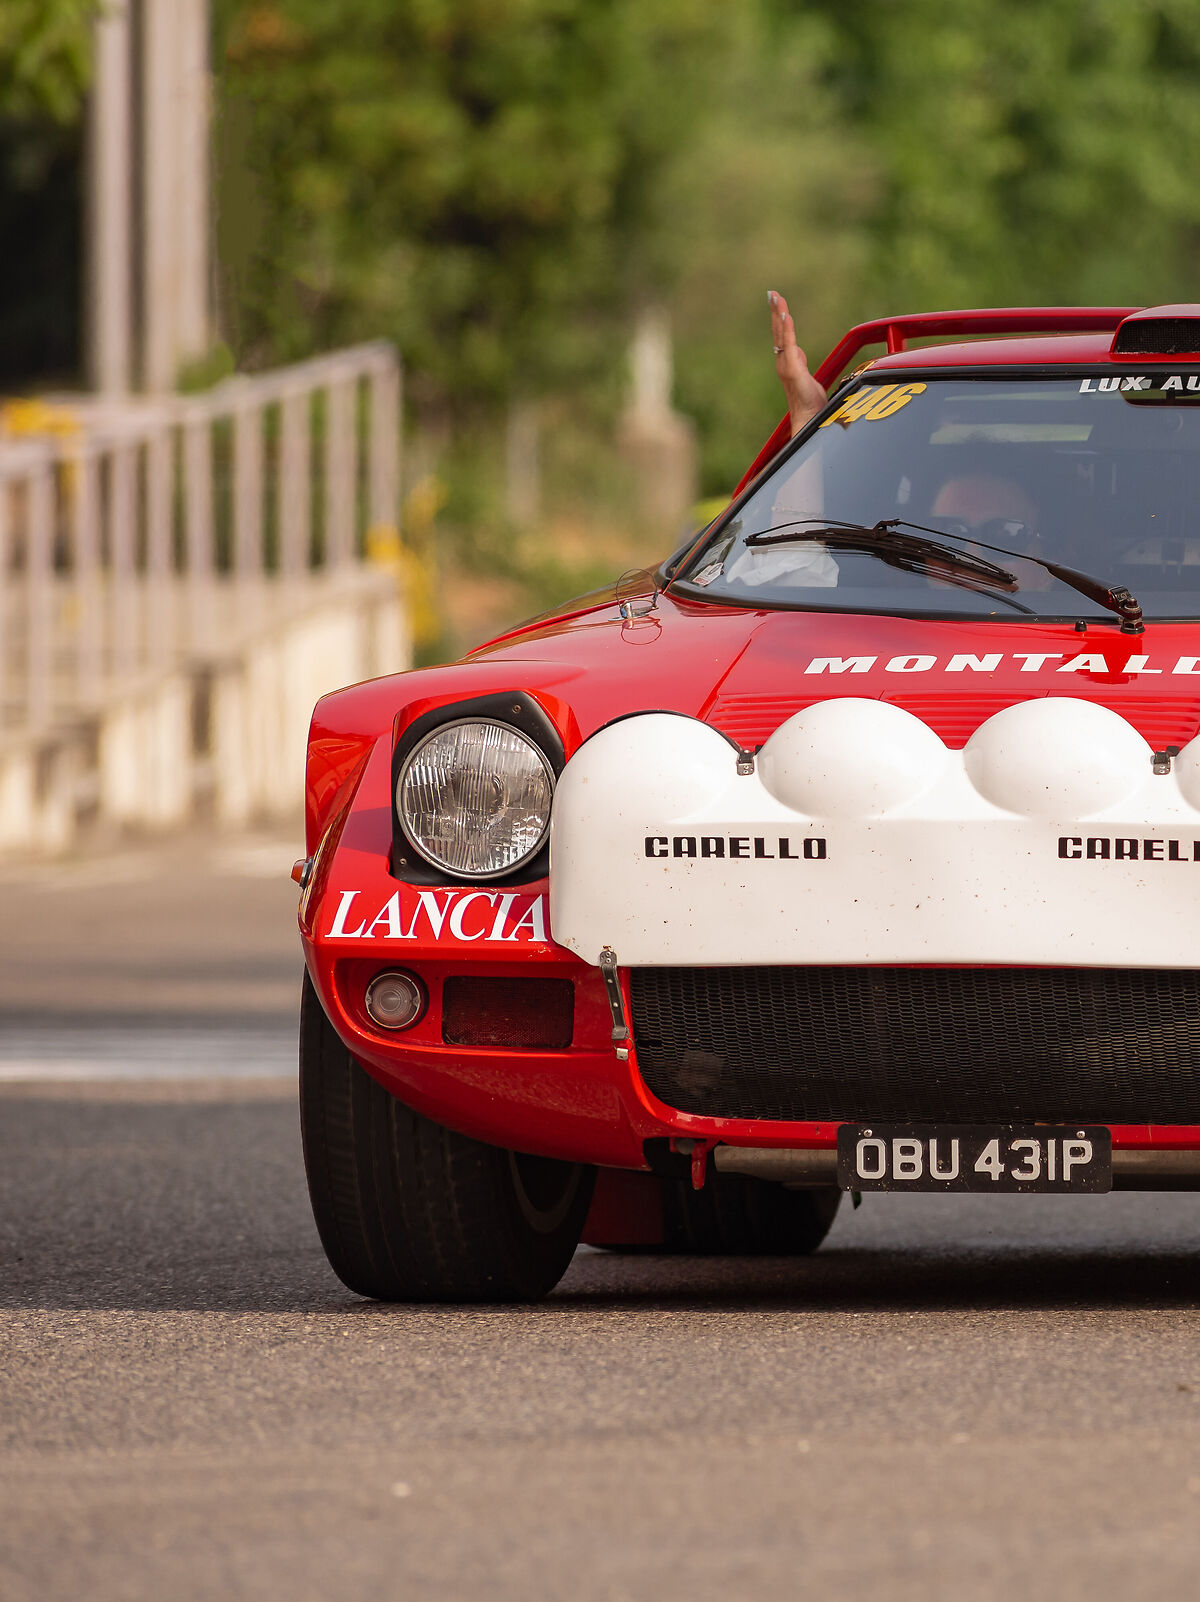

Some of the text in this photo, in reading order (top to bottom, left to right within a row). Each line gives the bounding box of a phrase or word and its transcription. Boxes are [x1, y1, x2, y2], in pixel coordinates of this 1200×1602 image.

[819, 383, 928, 428] 146
[1079, 376, 1145, 393] LUX
[645, 836, 828, 859] CARELLO
[325, 890, 549, 942] LANCIA
[856, 1138, 1094, 1181] OBU 431P
